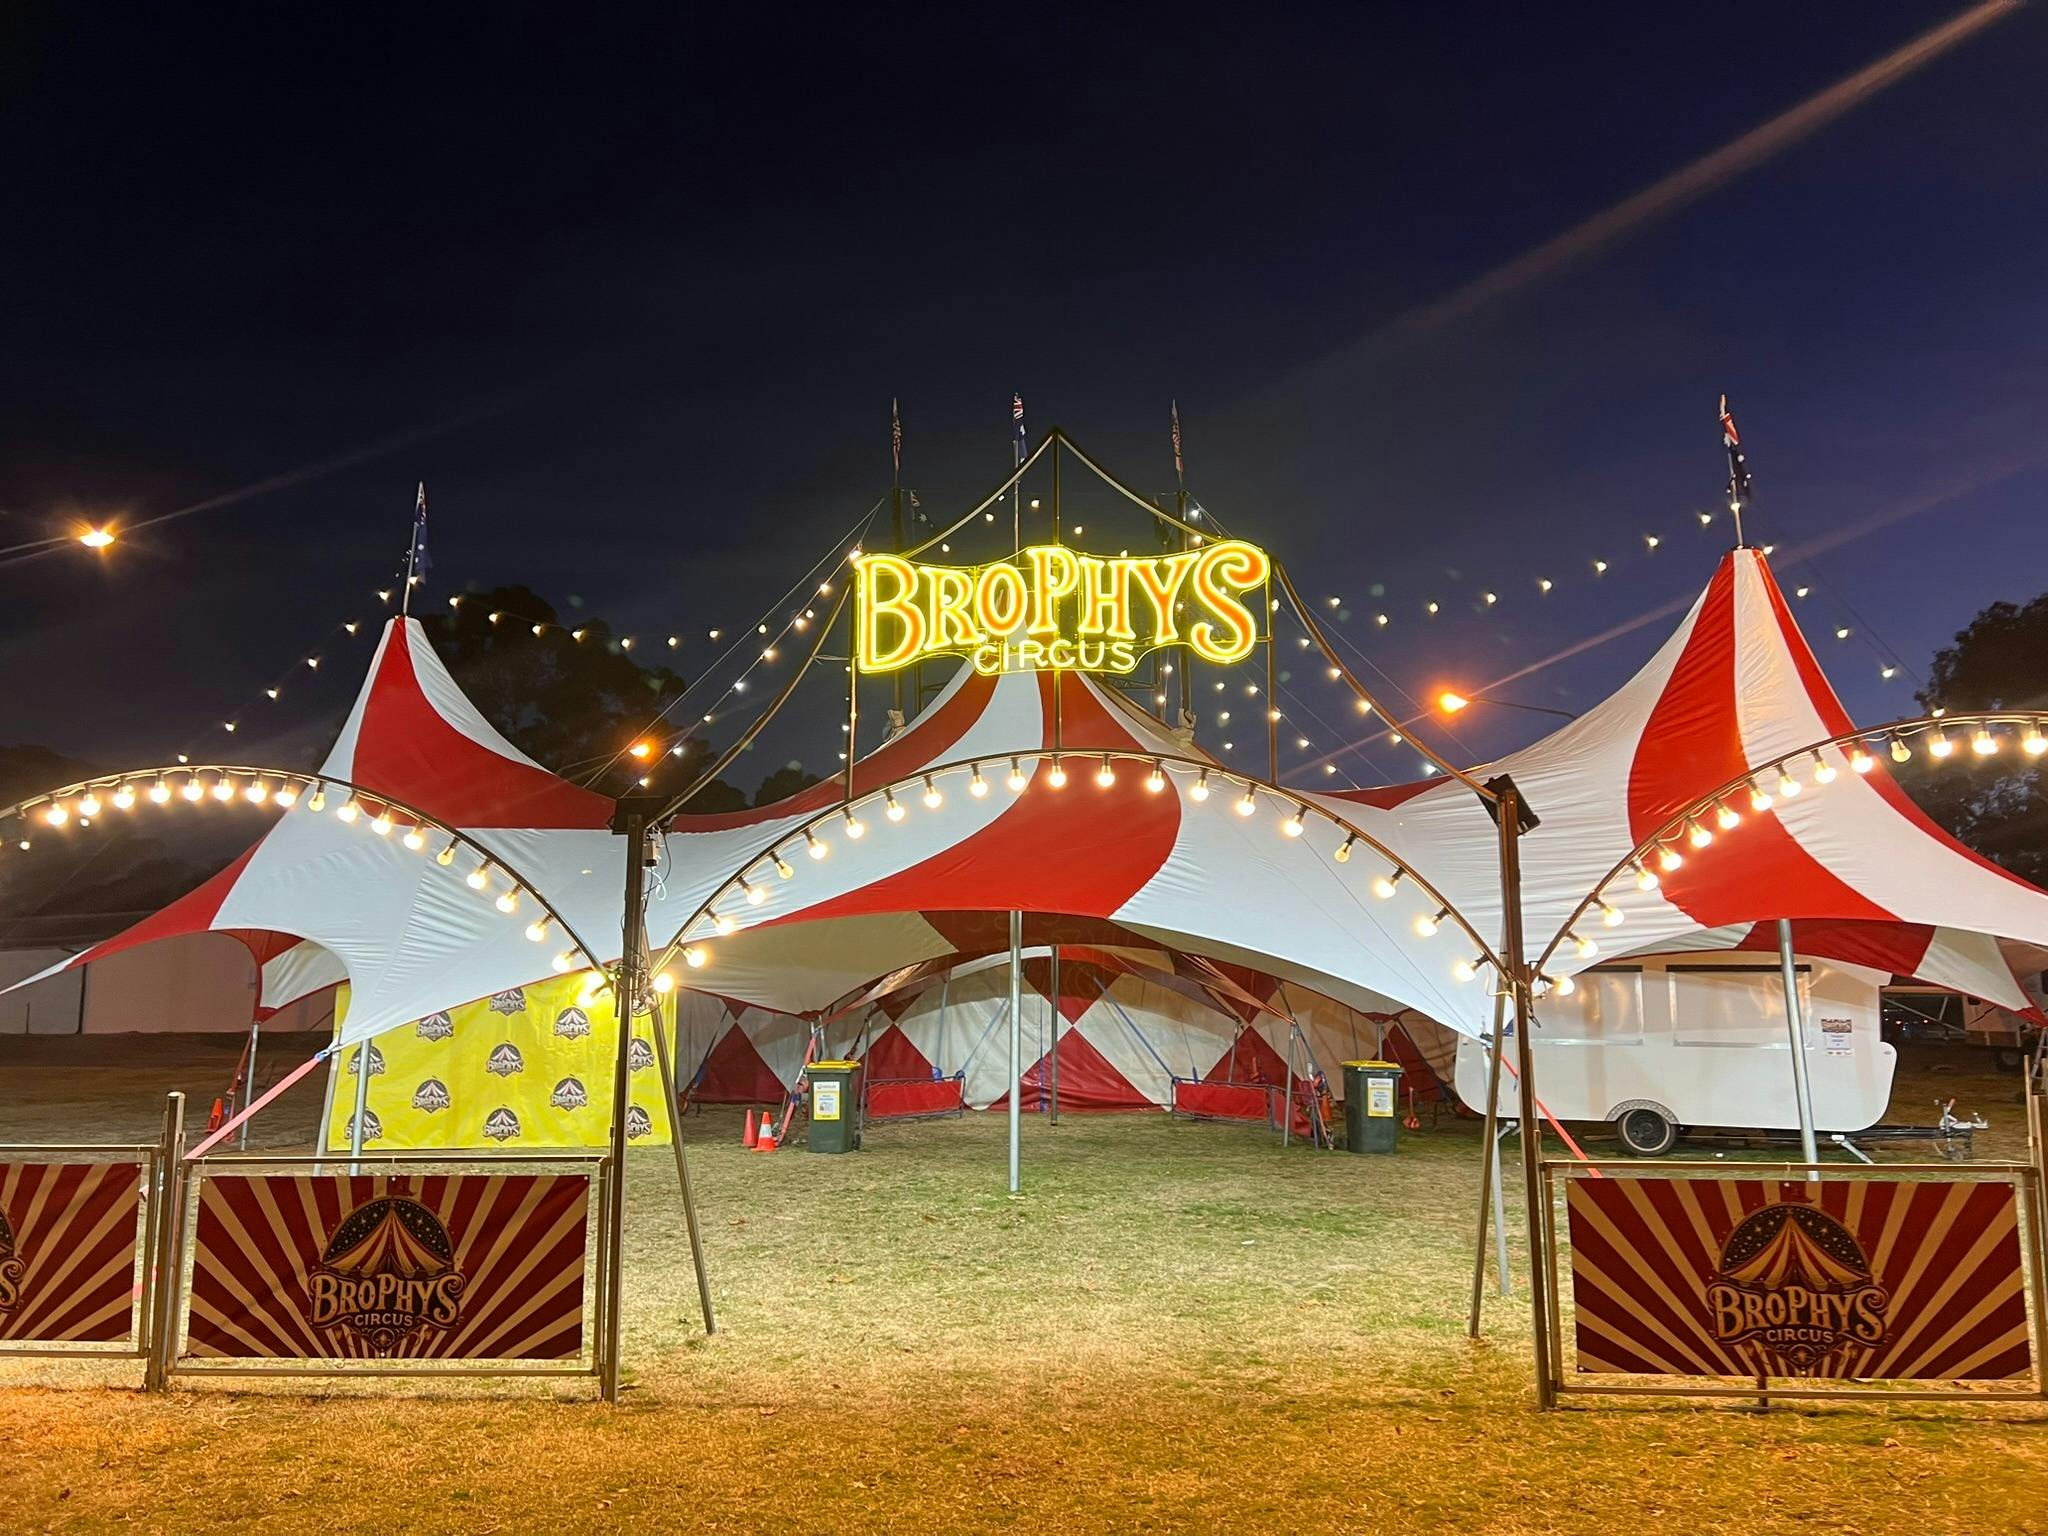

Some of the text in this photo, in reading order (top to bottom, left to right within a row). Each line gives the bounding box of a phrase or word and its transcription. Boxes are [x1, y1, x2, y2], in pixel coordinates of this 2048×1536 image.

[855, 540, 1270, 672] BROPHYS
[974, 639, 1135, 670] CIRCUS
[311, 1273, 462, 1324] BROPHYS
[1712, 1285, 1886, 1341] BROPHYS
[354, 1313, 413, 1326] CIRCUS
[1766, 1329, 1834, 1343] CIRCUS
